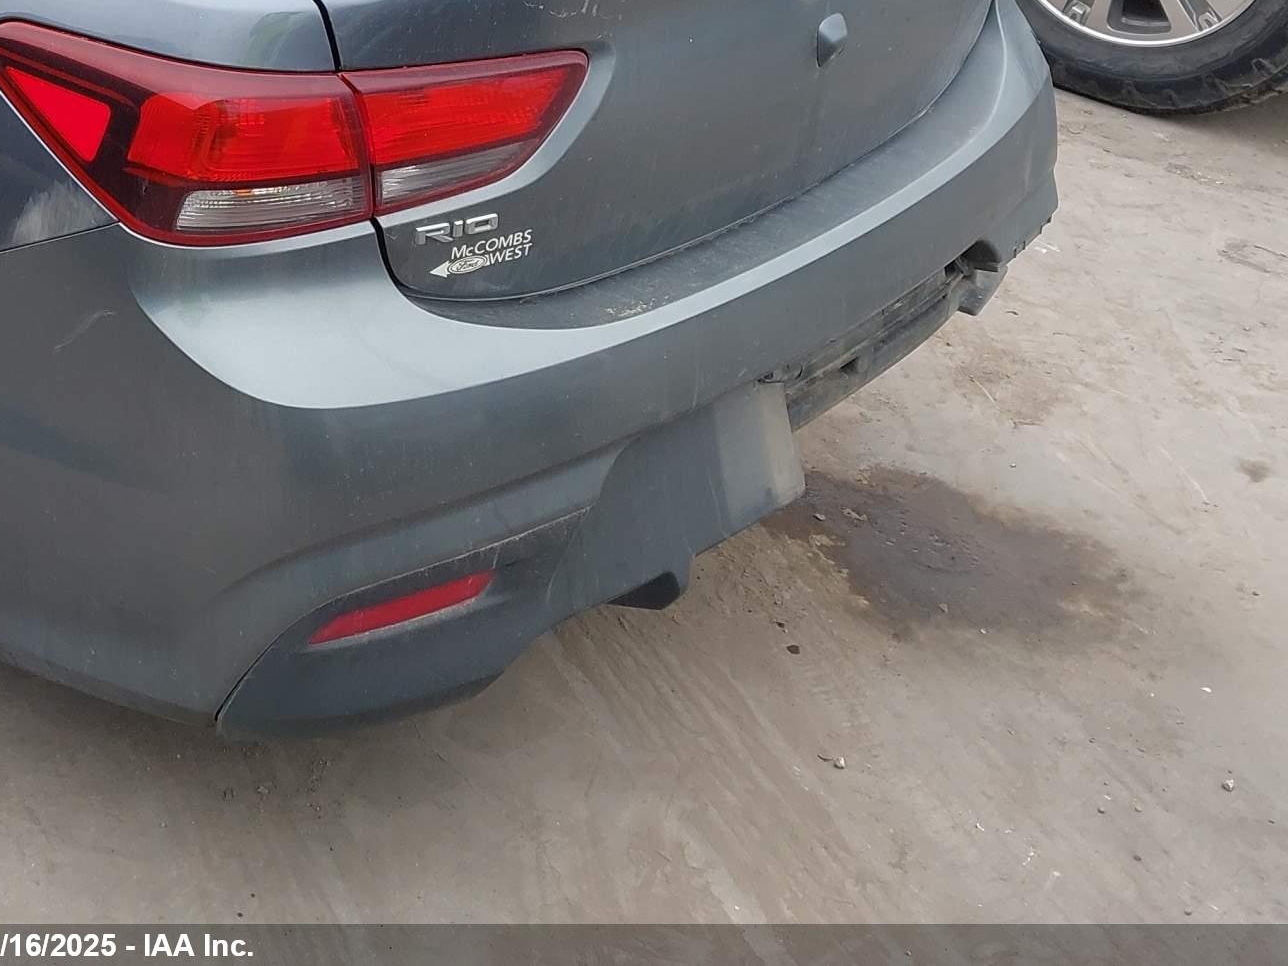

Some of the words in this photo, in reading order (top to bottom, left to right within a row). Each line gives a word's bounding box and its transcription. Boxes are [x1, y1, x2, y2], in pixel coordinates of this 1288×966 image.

[415, 213, 499, 245] RIO
[451, 229, 533, 260] McCOMBS
[489, 243, 533, 265] WEST
